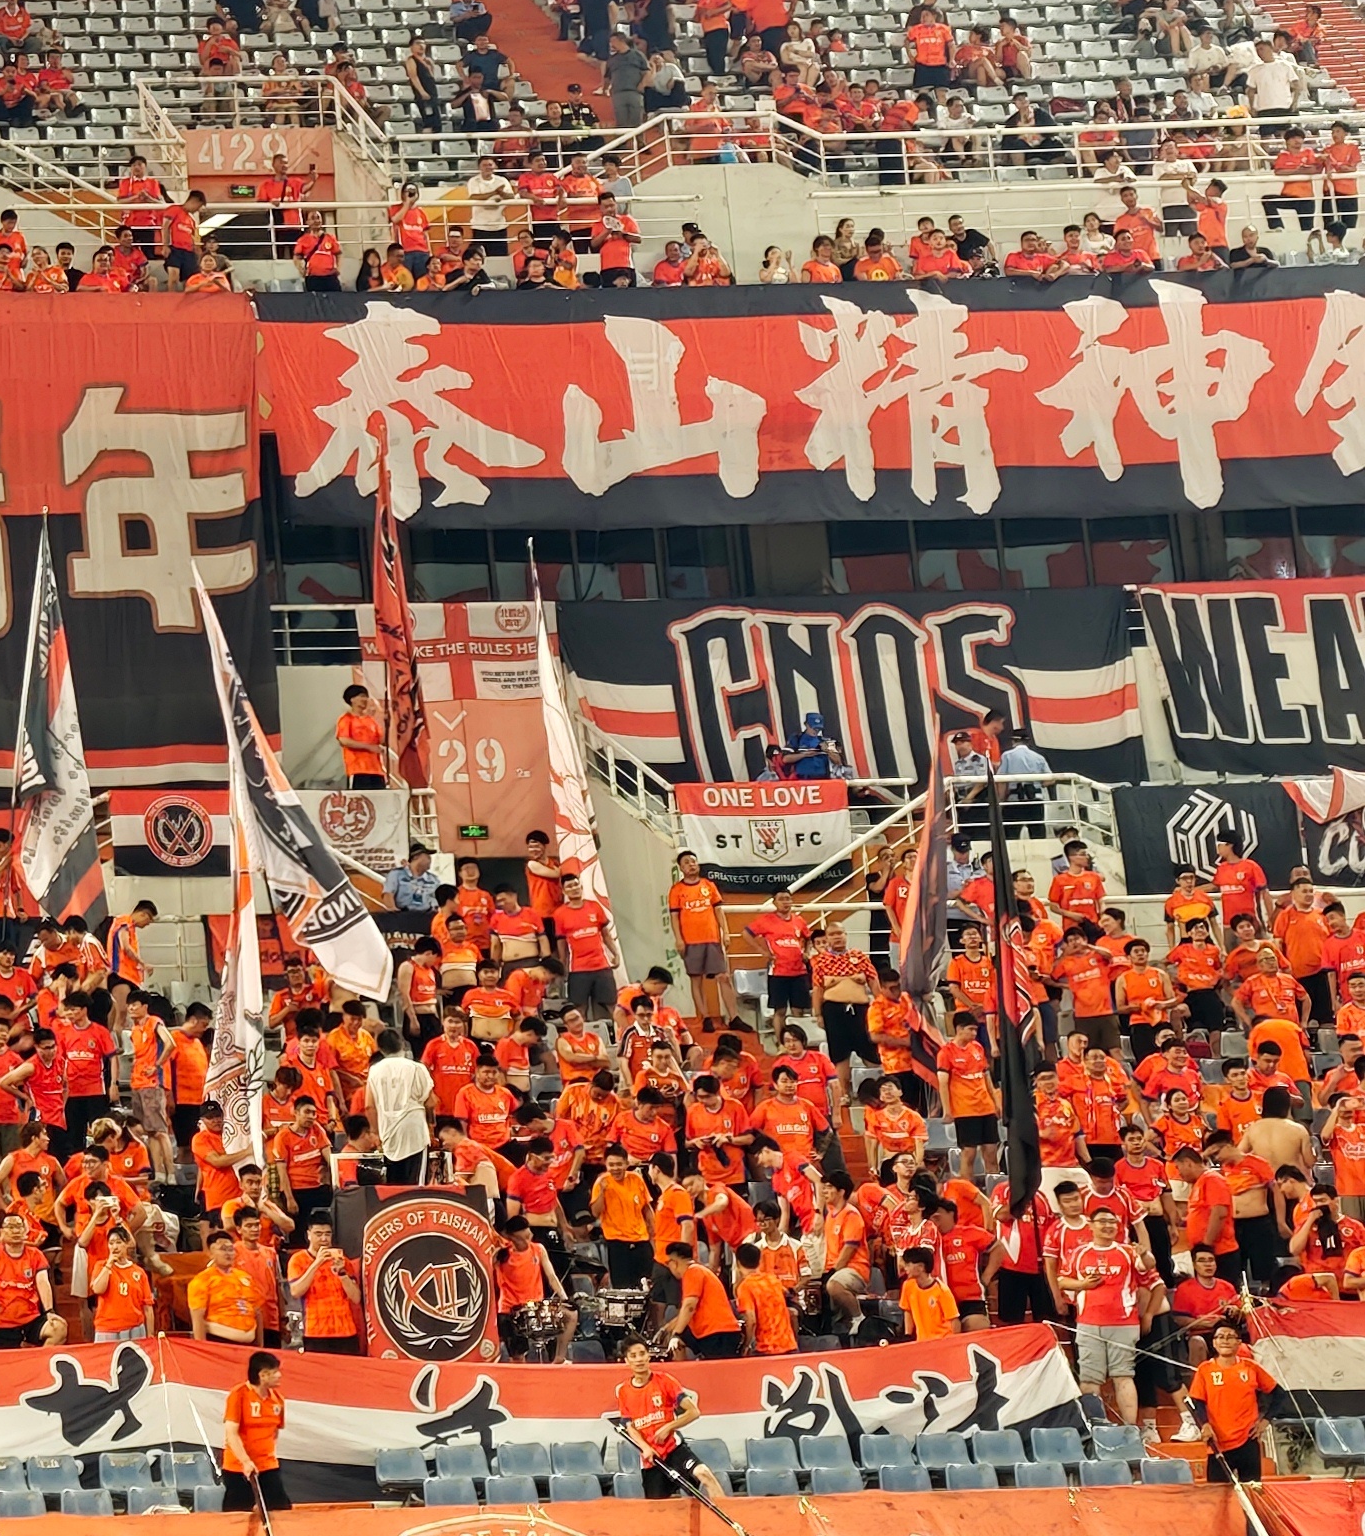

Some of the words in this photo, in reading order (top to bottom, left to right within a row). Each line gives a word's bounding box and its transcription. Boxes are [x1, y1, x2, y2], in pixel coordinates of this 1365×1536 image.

[197, 132, 289, 172] 429
[436, 641, 466, 657] THE
[469, 642, 513, 656] RULES
[516, 642, 538, 655] HE
[1140, 586, 1365, 746] WEA
[702, 786, 755, 808] ONE
[759, 785, 823, 808] LOVE
[707, 870, 751, 885] GREATEST
[752, 873, 766, 884] OF
[767, 872, 797, 884] CHINA
[797, 868, 846, 882] FTBALL
[406, 1209, 427, 1226] OF
[429, 1209, 490, 1248] TAISHAN
[250, 1401, 262, 1418] 12
